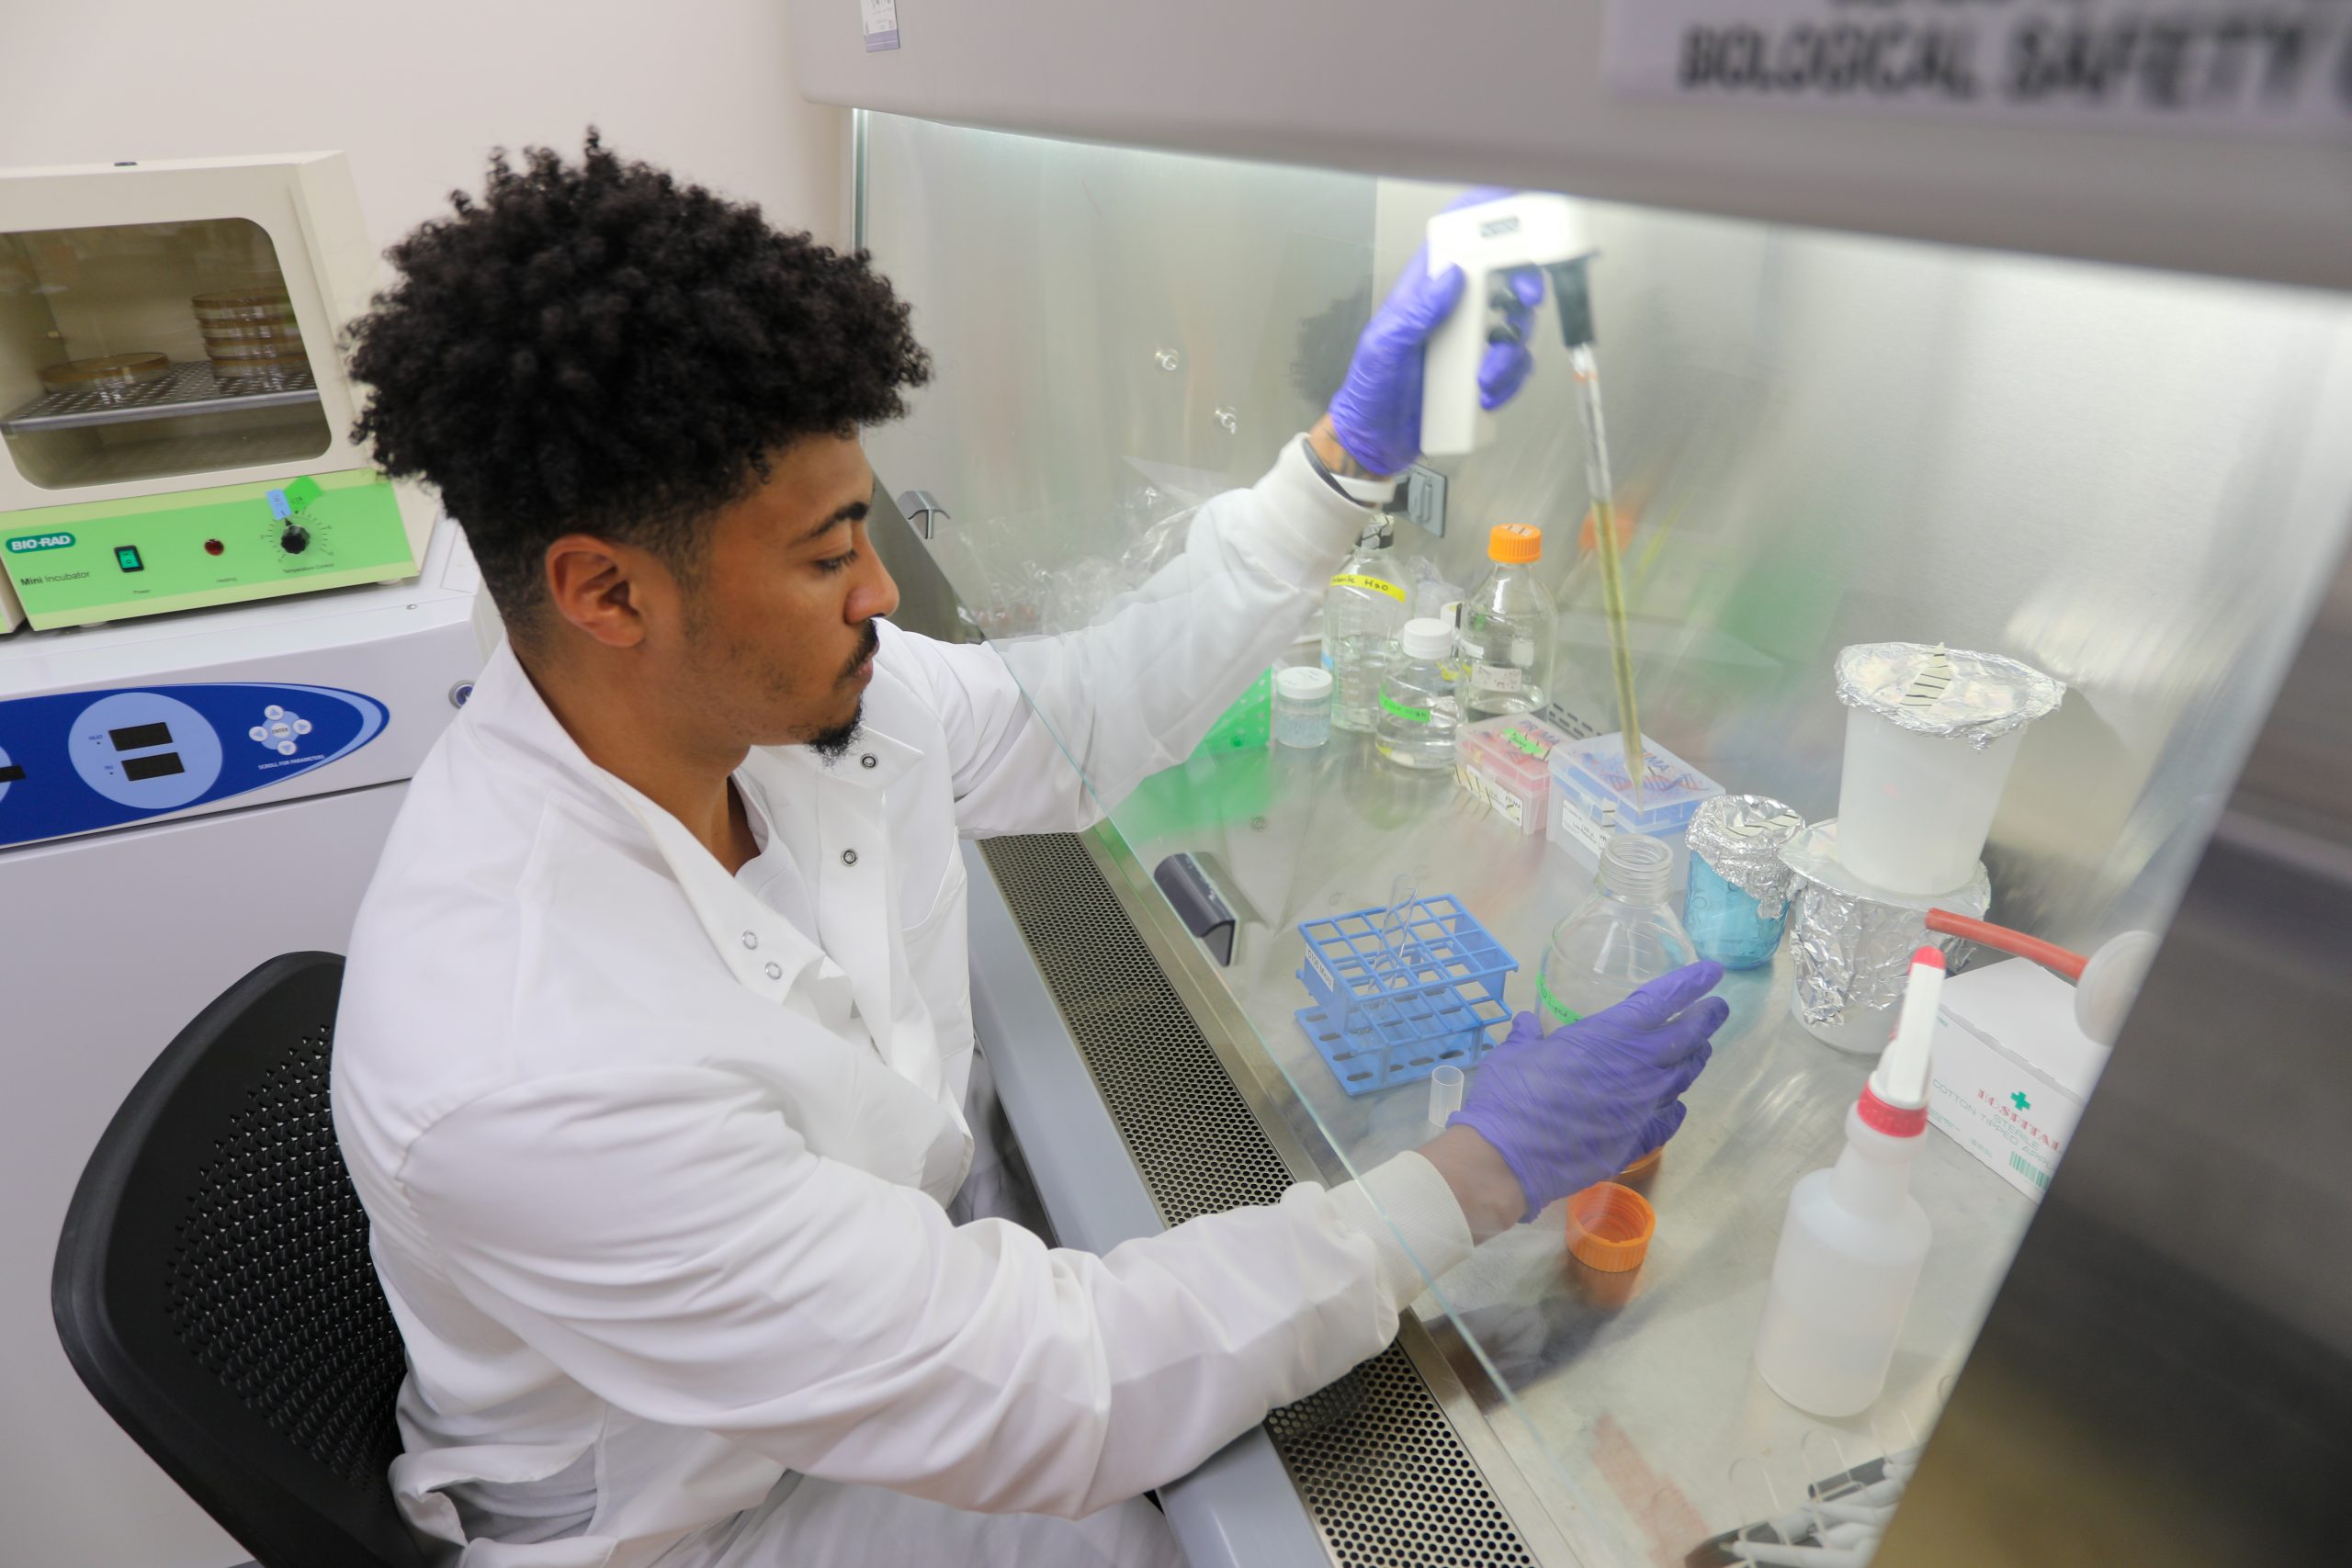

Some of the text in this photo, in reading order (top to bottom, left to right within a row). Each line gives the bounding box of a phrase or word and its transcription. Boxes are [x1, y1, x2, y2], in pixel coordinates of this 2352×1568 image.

[11, 535, 71, 551] BIO-RAD
[20, 571, 90, 586] Mini Incubator
[258, 761, 278, 770] SCROLL
[290, 754, 325, 764] PARAMETERS
[1932, 1078, 1977, 1115] COTTON
[1981, 1112, 2019, 1145] TIPPED
[1978, 1089, 2062, 1154] HOSPITAL
[1993, 1114, 2040, 1152] STERILE
